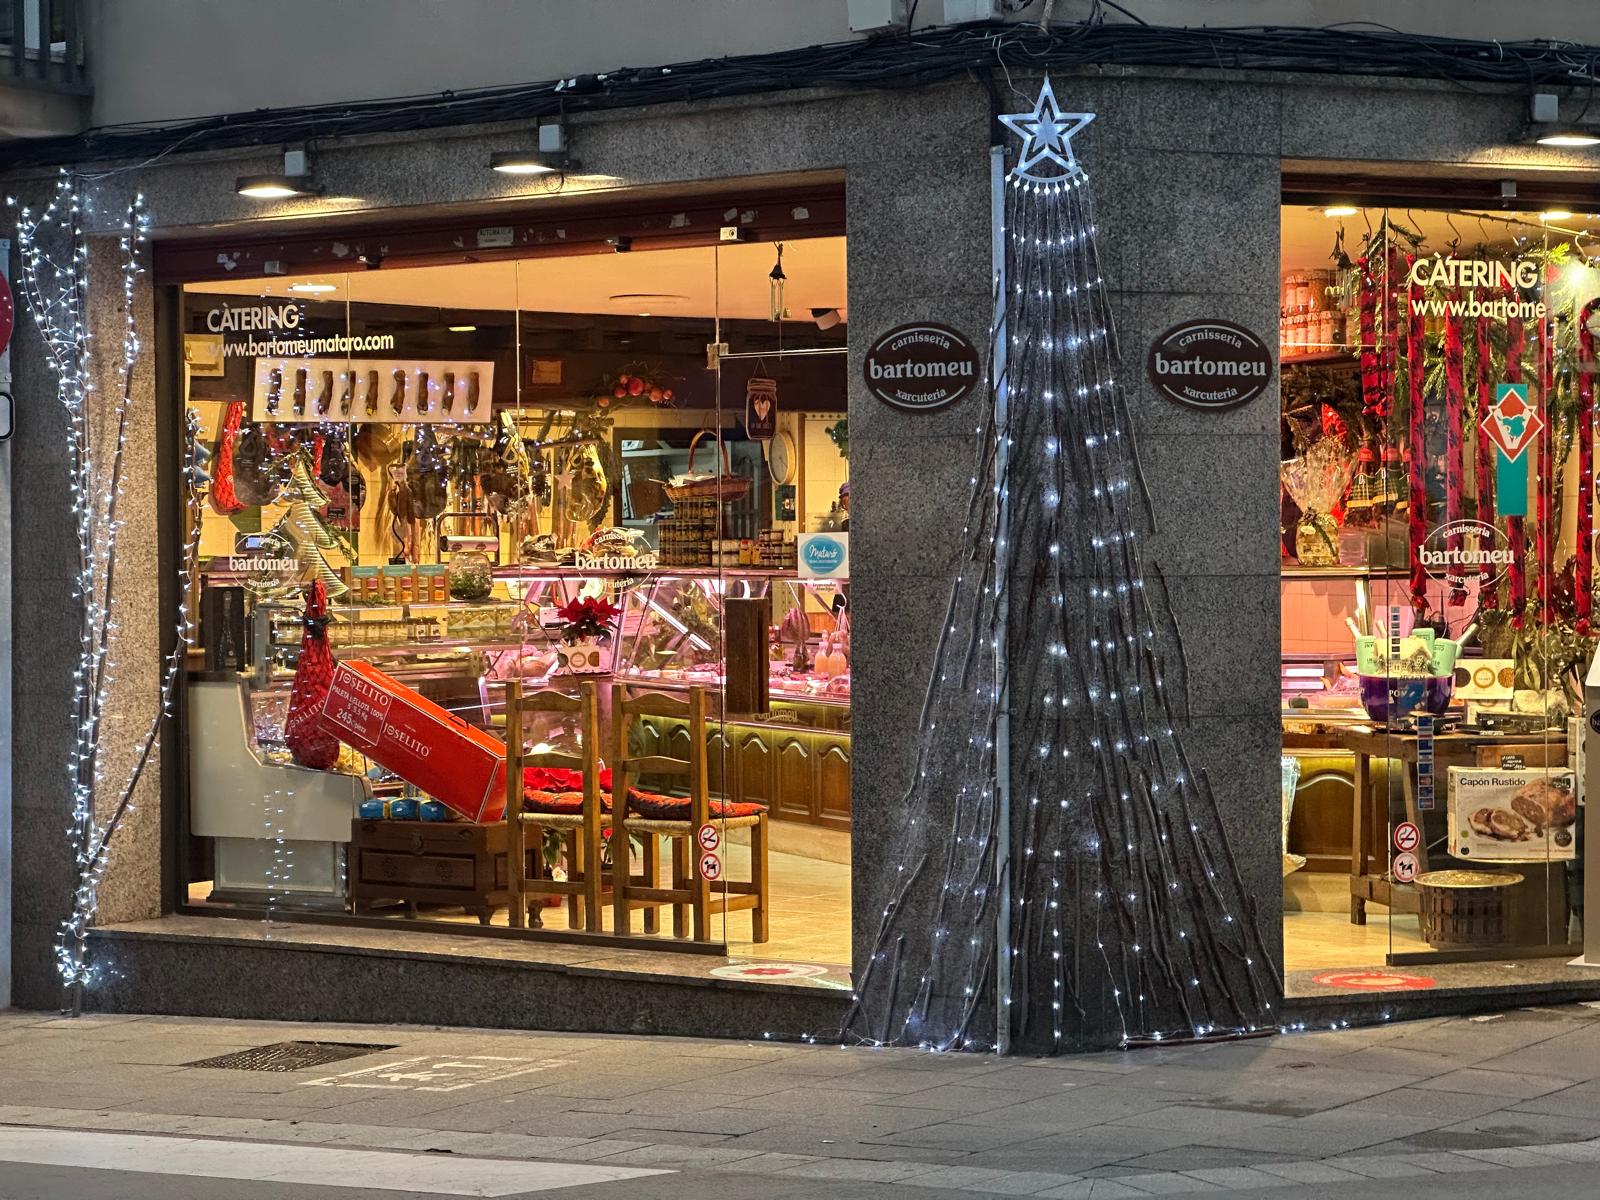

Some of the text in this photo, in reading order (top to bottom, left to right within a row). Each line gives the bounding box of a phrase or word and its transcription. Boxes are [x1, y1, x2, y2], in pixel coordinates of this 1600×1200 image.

[1411, 251, 1538, 289] CÀTERING
[206, 302, 300, 332] CÀTERING
[891, 332, 950, 351] carnisseria
[1179, 329, 1242, 349] carnisseria
[869, 358, 974, 379] bartomeu
[1155, 352, 1267, 377] bartomeu
[895, 388, 947, 402] xarcuteria
[1183, 386, 1238, 401] xarcuteria
[1442, 524, 1491, 538] carnisseria
[228, 555, 299, 571] bartomeu
[574, 551, 657, 570] bartomeu
[1418, 544, 1515, 565] bartomeu
[338, 669, 390, 706] JOSELITO
[383, 722, 431, 758] JOSELITO
[1460, 777, 1526, 788] Capón Rustido
